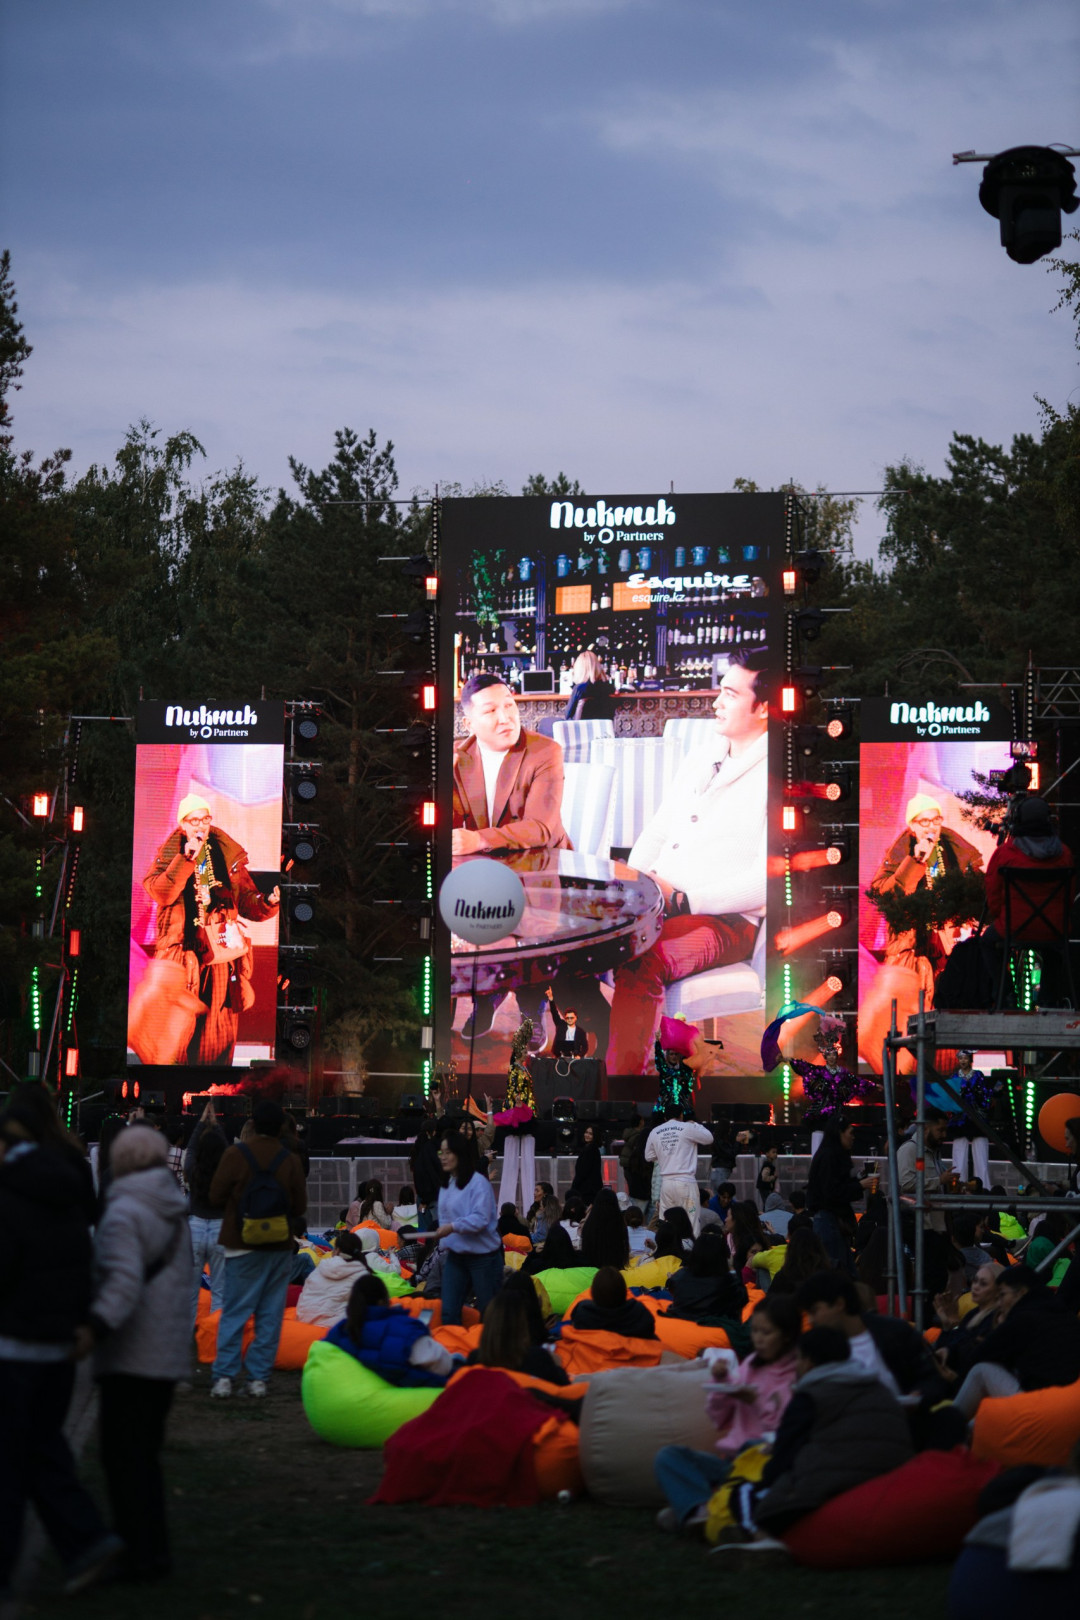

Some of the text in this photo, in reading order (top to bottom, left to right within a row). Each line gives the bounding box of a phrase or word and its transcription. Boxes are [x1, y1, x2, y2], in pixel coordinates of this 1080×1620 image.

[583, 530, 664, 545] by Partners
[626, 571, 751, 592] Esquire
[632, 592, 685, 604] esquire.kz
[189, 728, 249, 739] by Partners
[916, 725, 981, 737] by Partners
